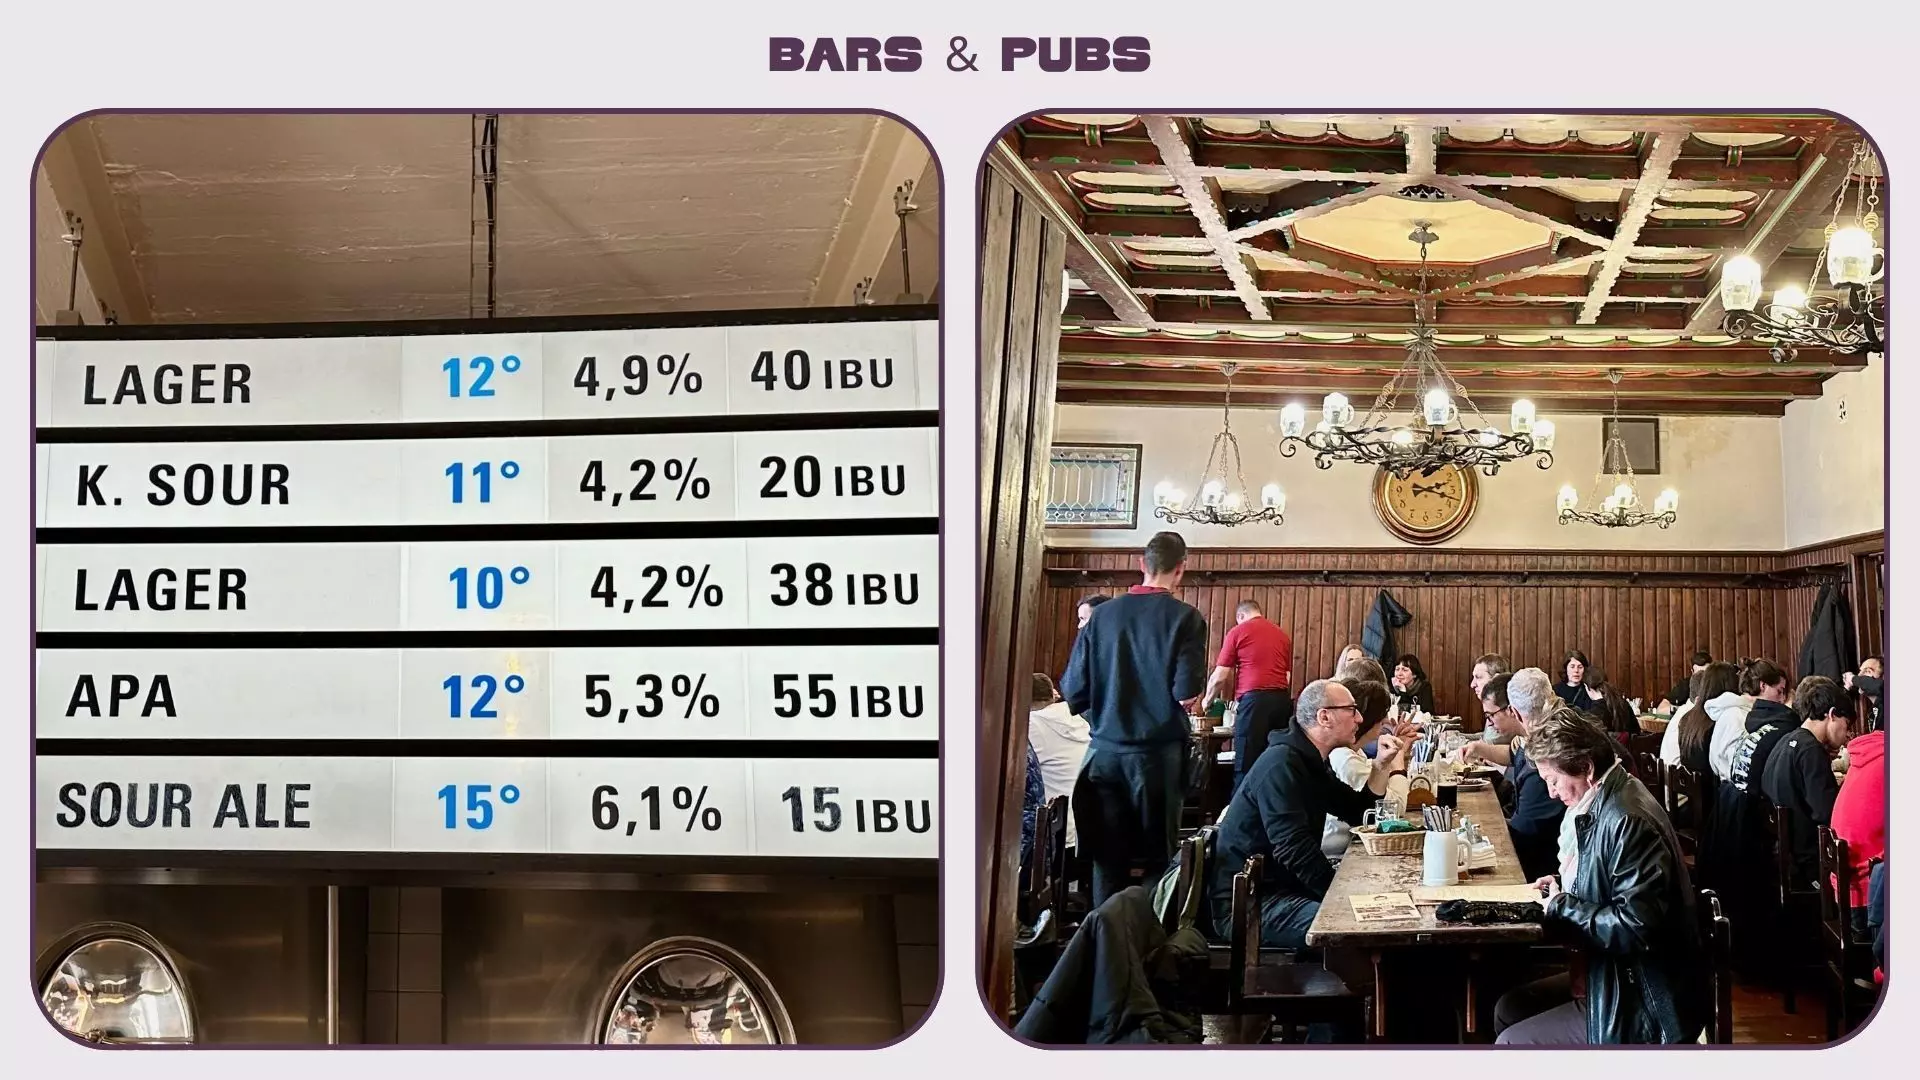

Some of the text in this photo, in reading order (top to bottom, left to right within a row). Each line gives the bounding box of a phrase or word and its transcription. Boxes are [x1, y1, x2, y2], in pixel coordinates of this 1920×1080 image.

[83, 350, 894, 405] LAGER 12° 4,9% 40 IBU
[77, 455, 906, 507] K. SOUR 11° 4,2% 20 IBU
[74, 562, 919, 614] LAGER 10° 4,2% 38 IBU
[65, 673, 924, 724] APA 12° 5,3% 55 IBU
[56, 781, 931, 837] SOUR ALE 15° 6,1% 15 IBU
